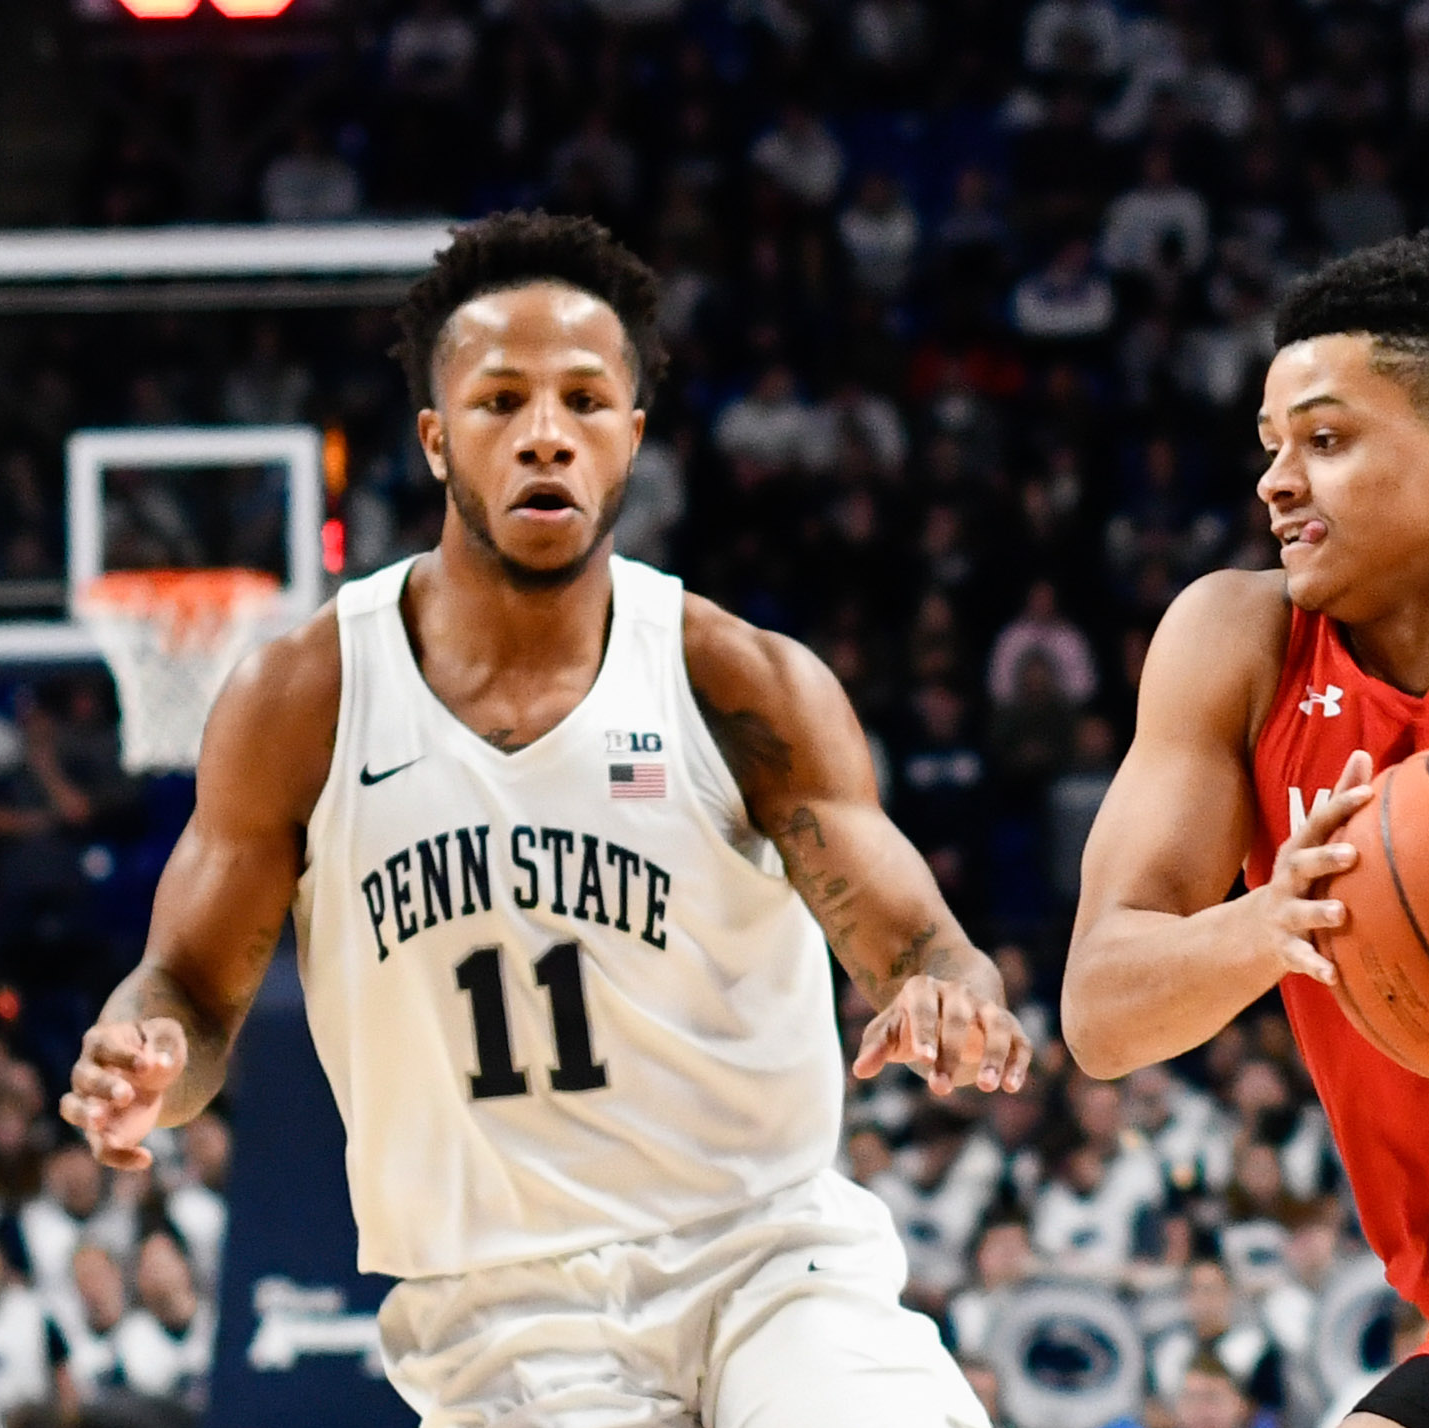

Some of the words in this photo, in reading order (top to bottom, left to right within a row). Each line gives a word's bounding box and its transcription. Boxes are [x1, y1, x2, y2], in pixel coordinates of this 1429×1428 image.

[361, 823, 492, 963] PENN
[510, 823, 671, 952] STATE
[452, 940, 609, 1101] 11
